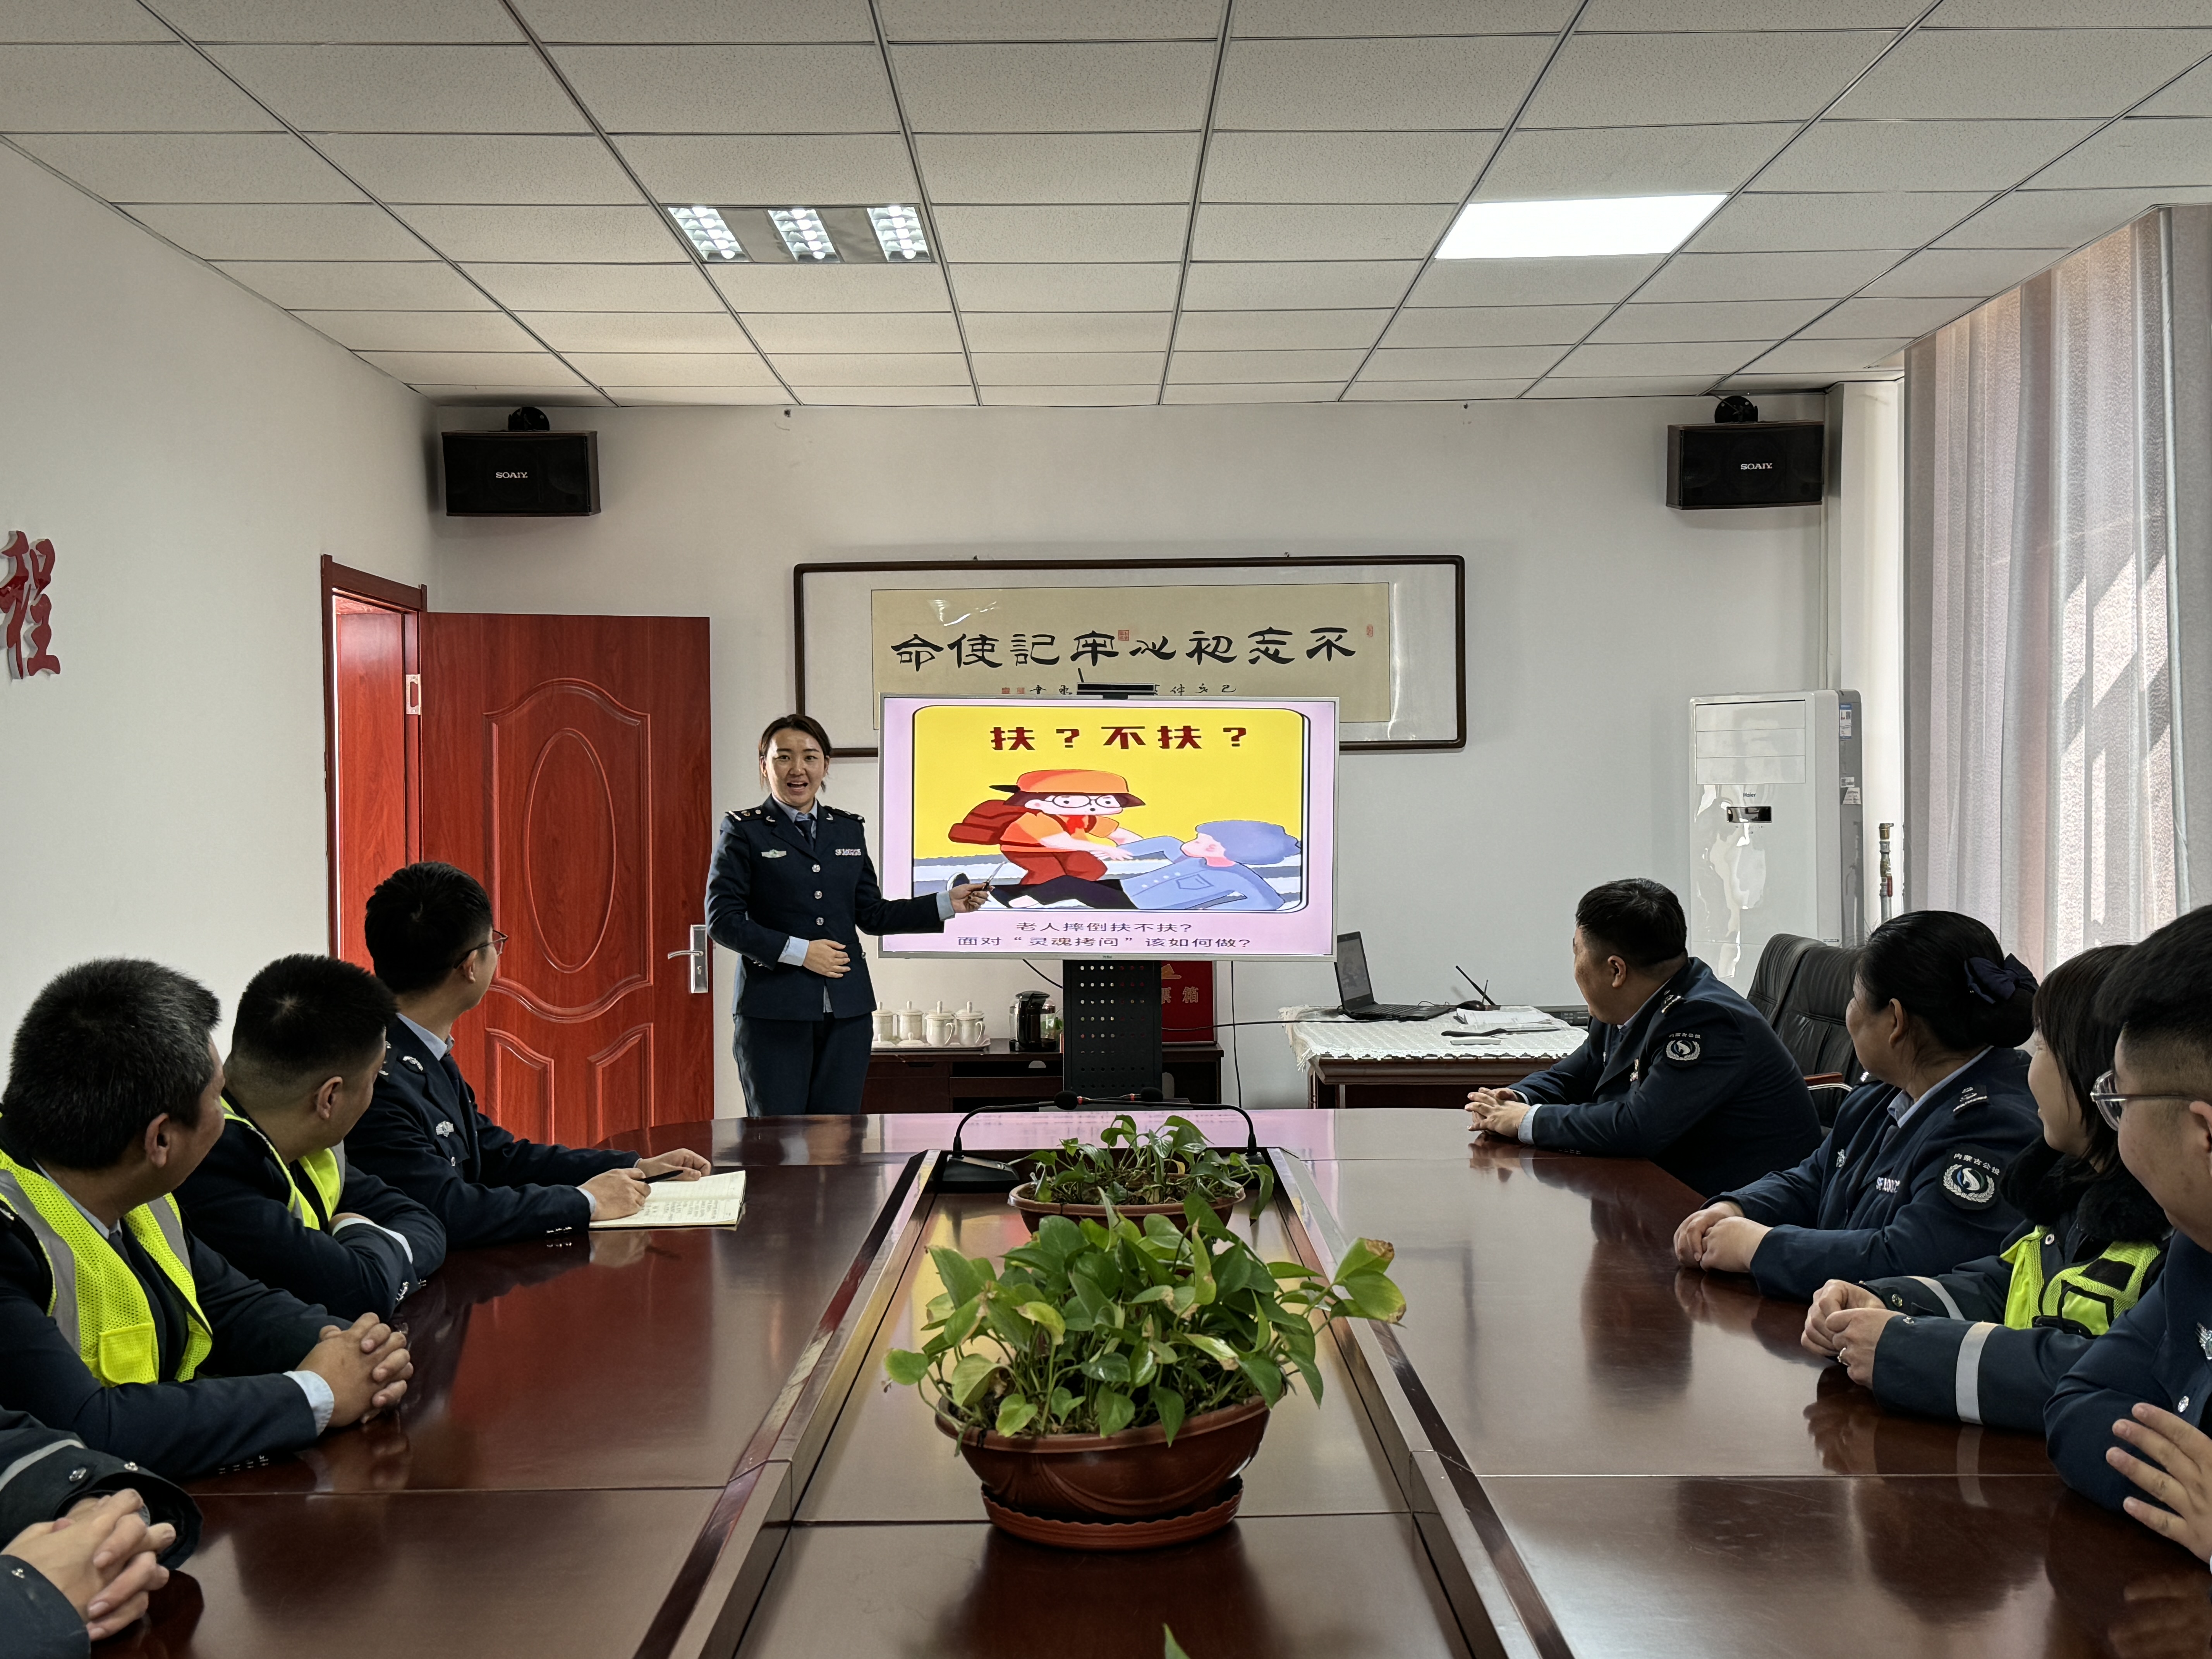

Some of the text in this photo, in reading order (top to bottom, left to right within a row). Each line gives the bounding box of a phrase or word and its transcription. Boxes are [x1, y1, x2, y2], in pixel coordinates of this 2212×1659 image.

[990, 725, 1247, 750] 扶?不扶?
[1016, 922, 1193, 932] 老人摔倒扶不扶?
